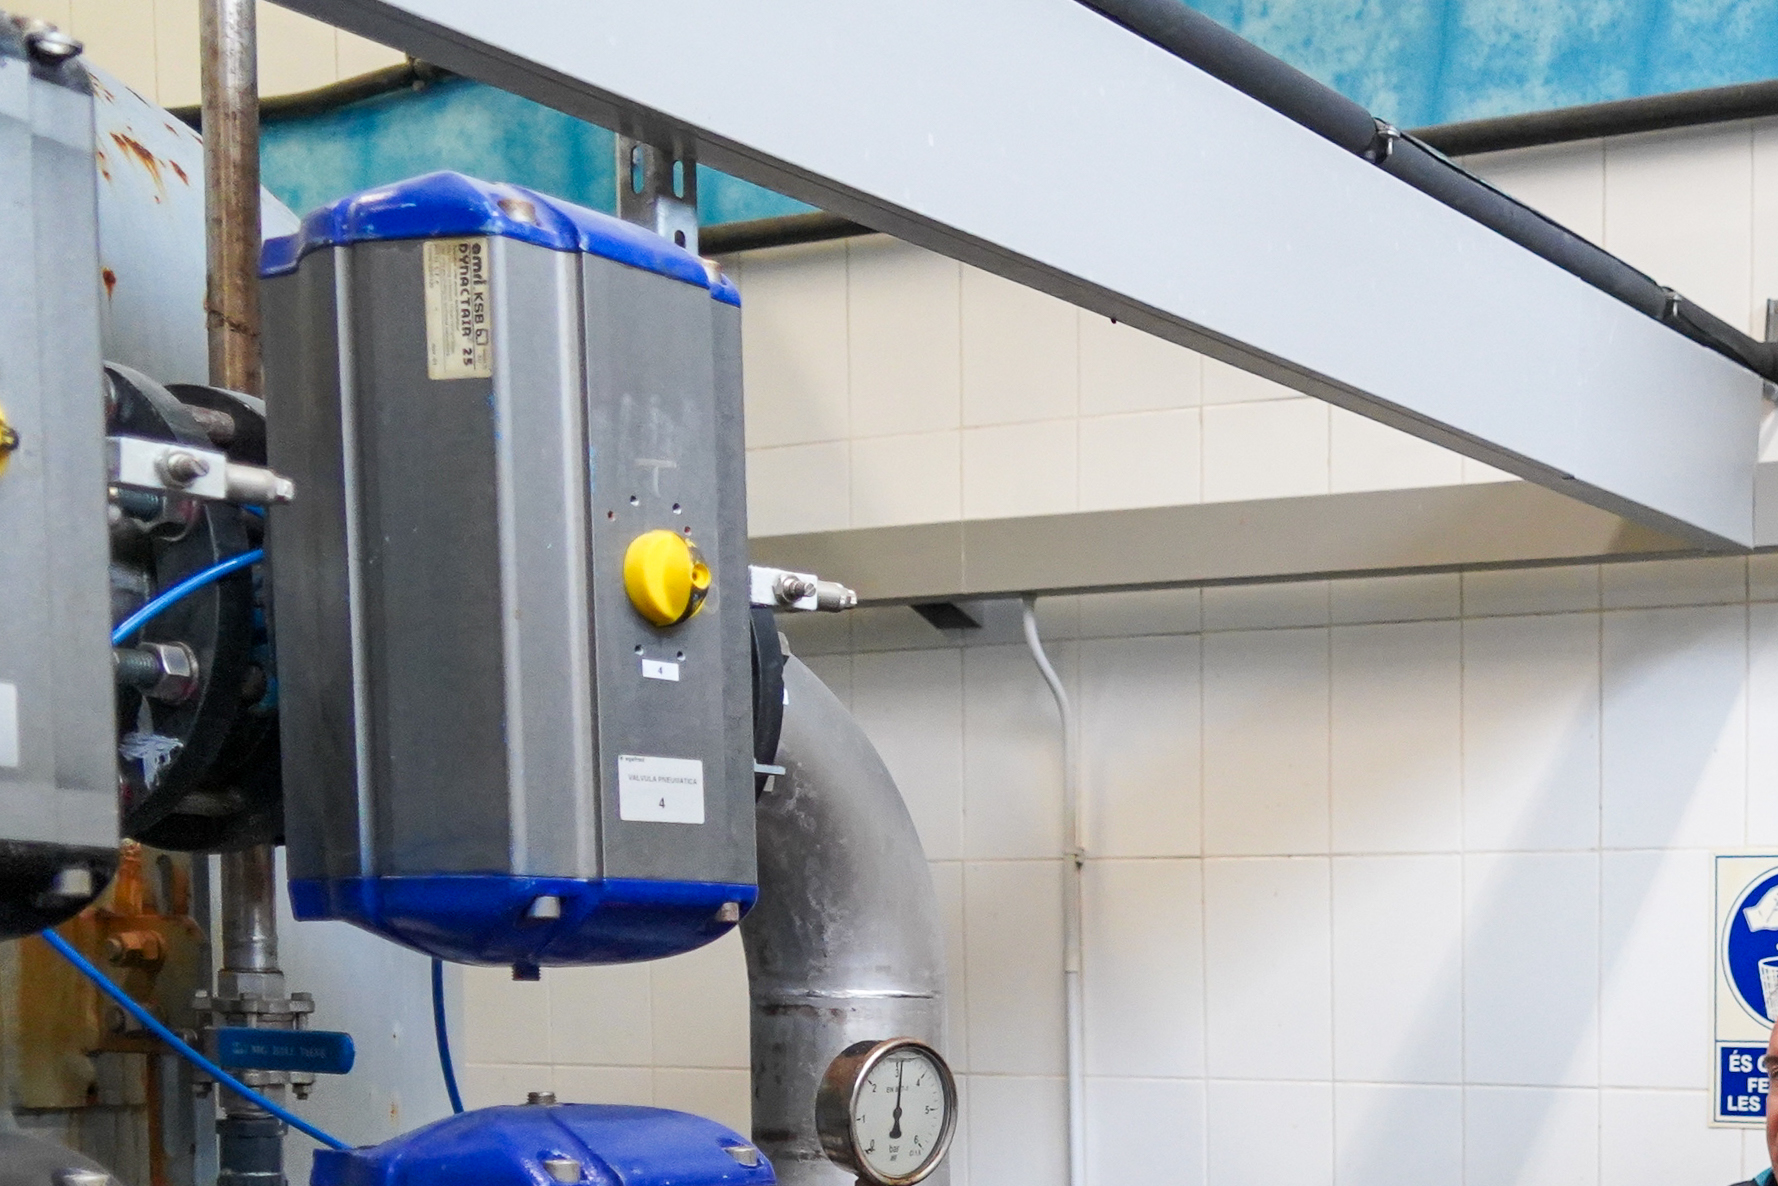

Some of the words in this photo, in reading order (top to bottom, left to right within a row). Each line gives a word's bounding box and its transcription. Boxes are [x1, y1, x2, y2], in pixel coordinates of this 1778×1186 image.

[459, 243, 472, 337] DYNACTAIR
[474, 292, 484, 324] KSB
[462, 348, 473, 366] 25
[659, 797, 665, 808] 4
[1729, 1049, 1753, 1073] ÉS
[1727, 1095, 1761, 1112] LES
